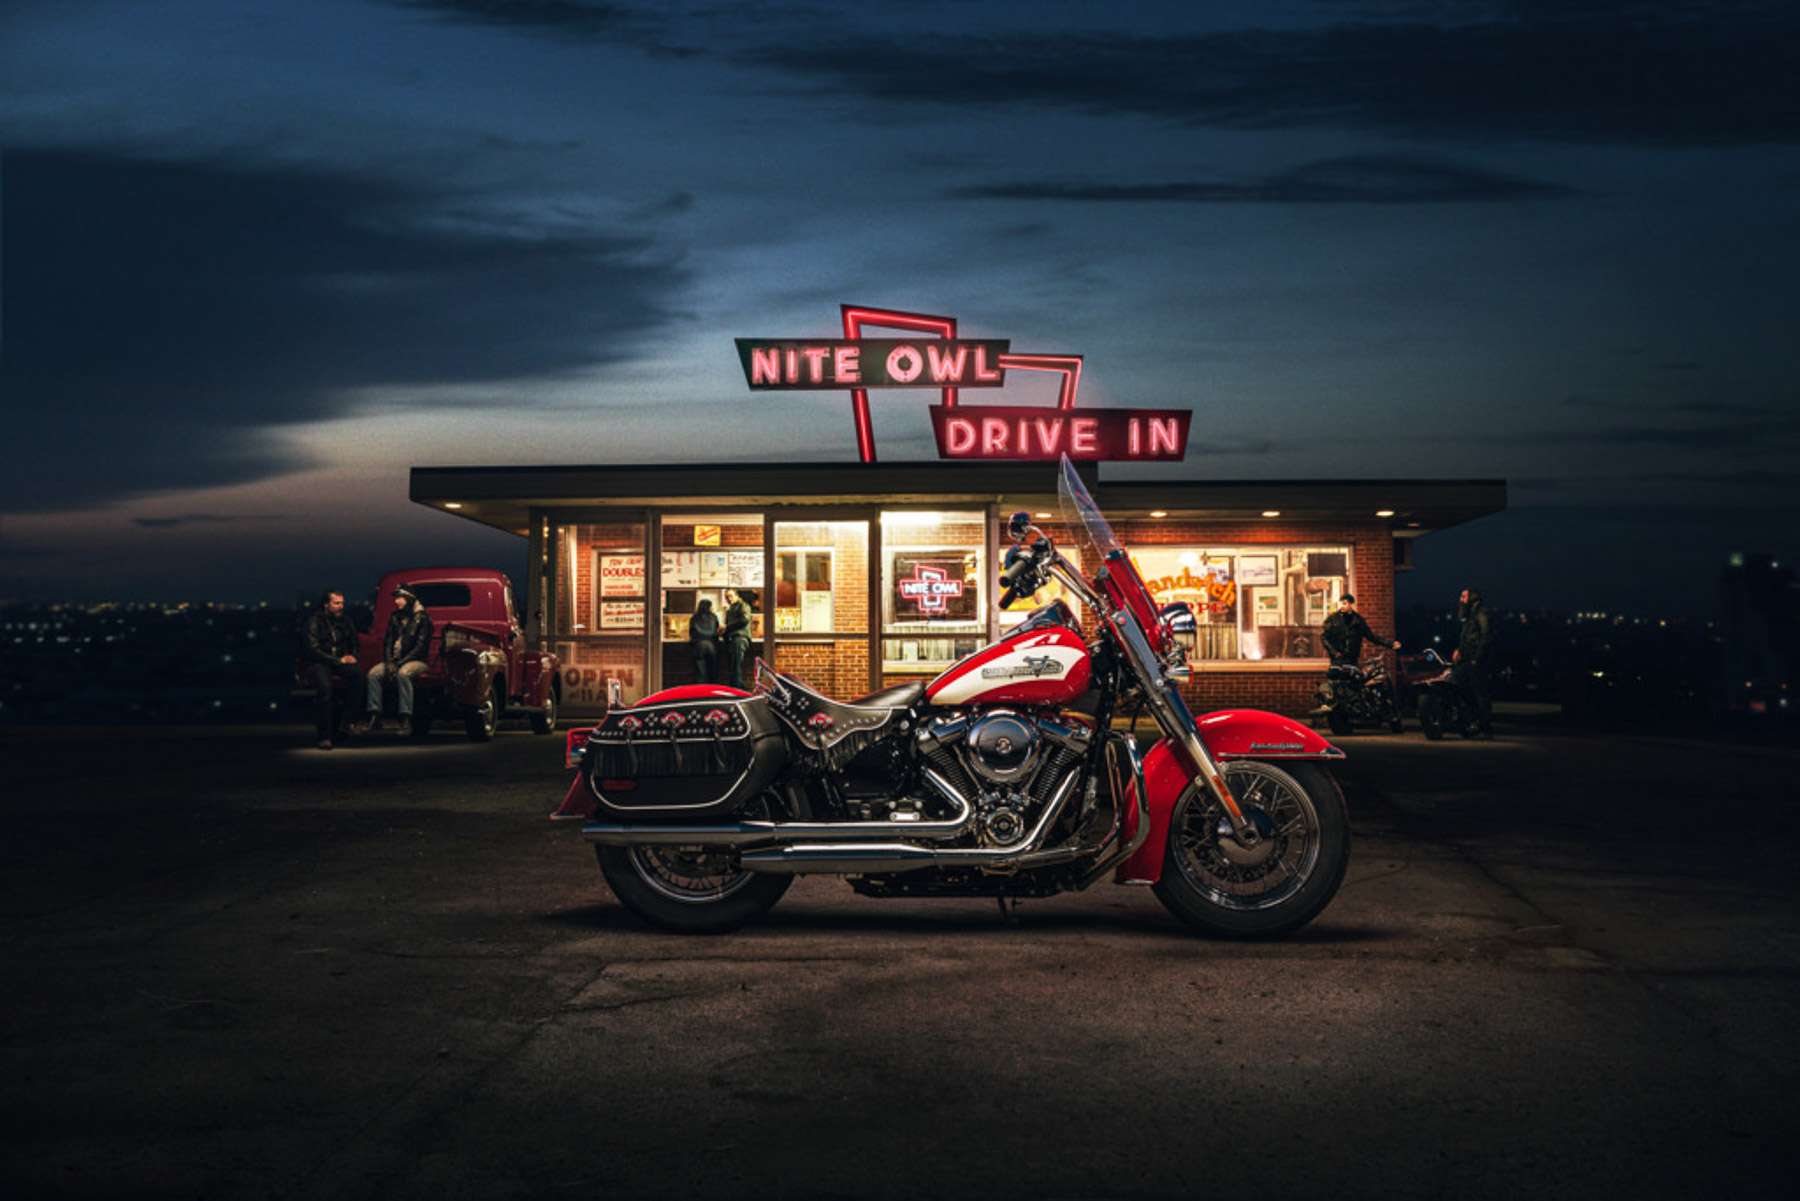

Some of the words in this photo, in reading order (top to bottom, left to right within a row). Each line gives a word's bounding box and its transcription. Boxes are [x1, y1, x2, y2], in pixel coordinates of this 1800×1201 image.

[751, 346, 861, 384] NITE
[885, 345, 1000, 382] OWL
[946, 417, 1099, 453] DRIVE
[1127, 417, 1179, 452] IN
[904, 582, 929, 594] NITE
[932, 582, 959, 594] OWL
[565, 667, 634, 688] OPEN
